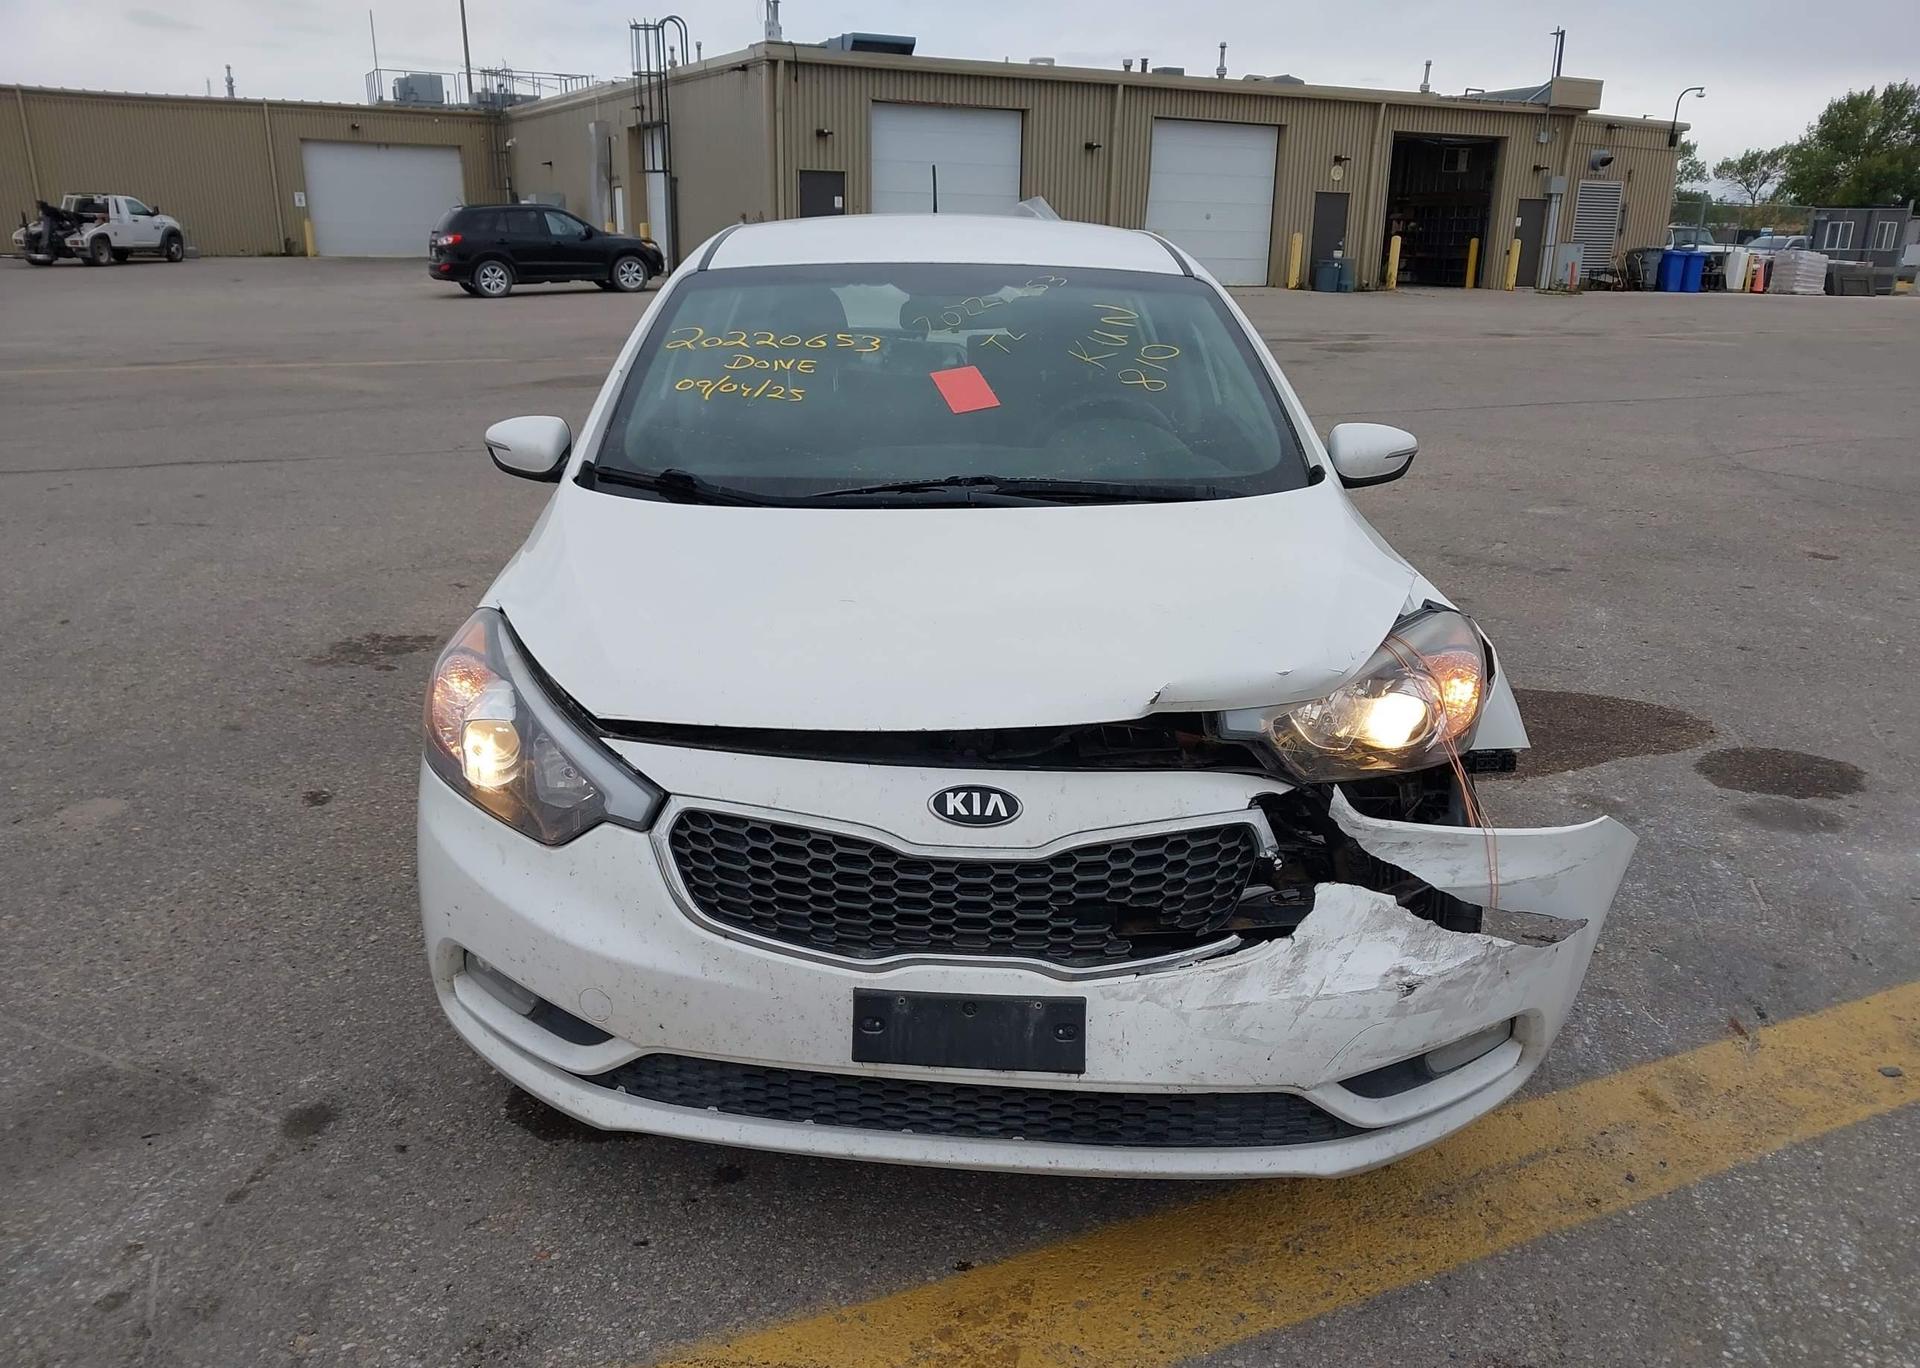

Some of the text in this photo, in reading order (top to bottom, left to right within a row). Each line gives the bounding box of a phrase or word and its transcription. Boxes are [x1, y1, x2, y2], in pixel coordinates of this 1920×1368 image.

[665, 327, 882, 352] 20220653
[724, 354, 817, 374] DONE
[945, 792, 1008, 817] KIA
